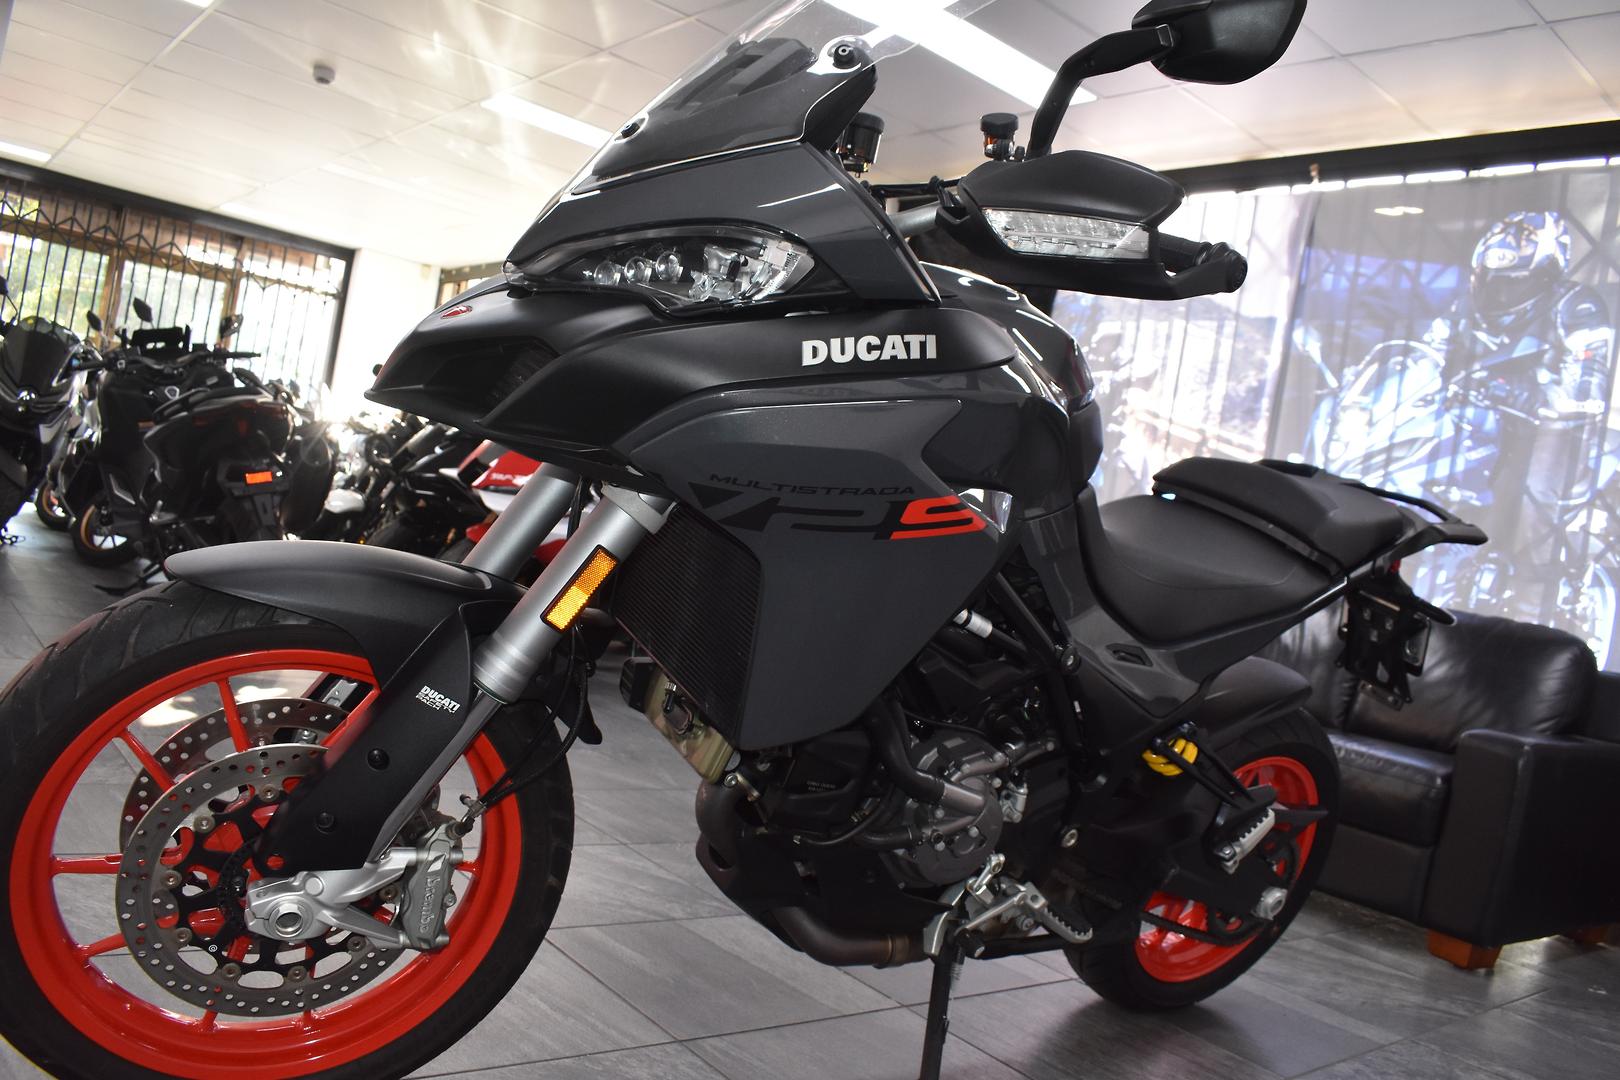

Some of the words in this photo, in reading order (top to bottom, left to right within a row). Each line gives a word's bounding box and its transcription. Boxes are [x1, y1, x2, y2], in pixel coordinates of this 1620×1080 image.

[802, 334, 937, 366] DUCATI
[709, 473, 915, 496] MULTISTRADA
[420, 685, 460, 712] DUCATI
[420, 877, 441, 933] brembo
